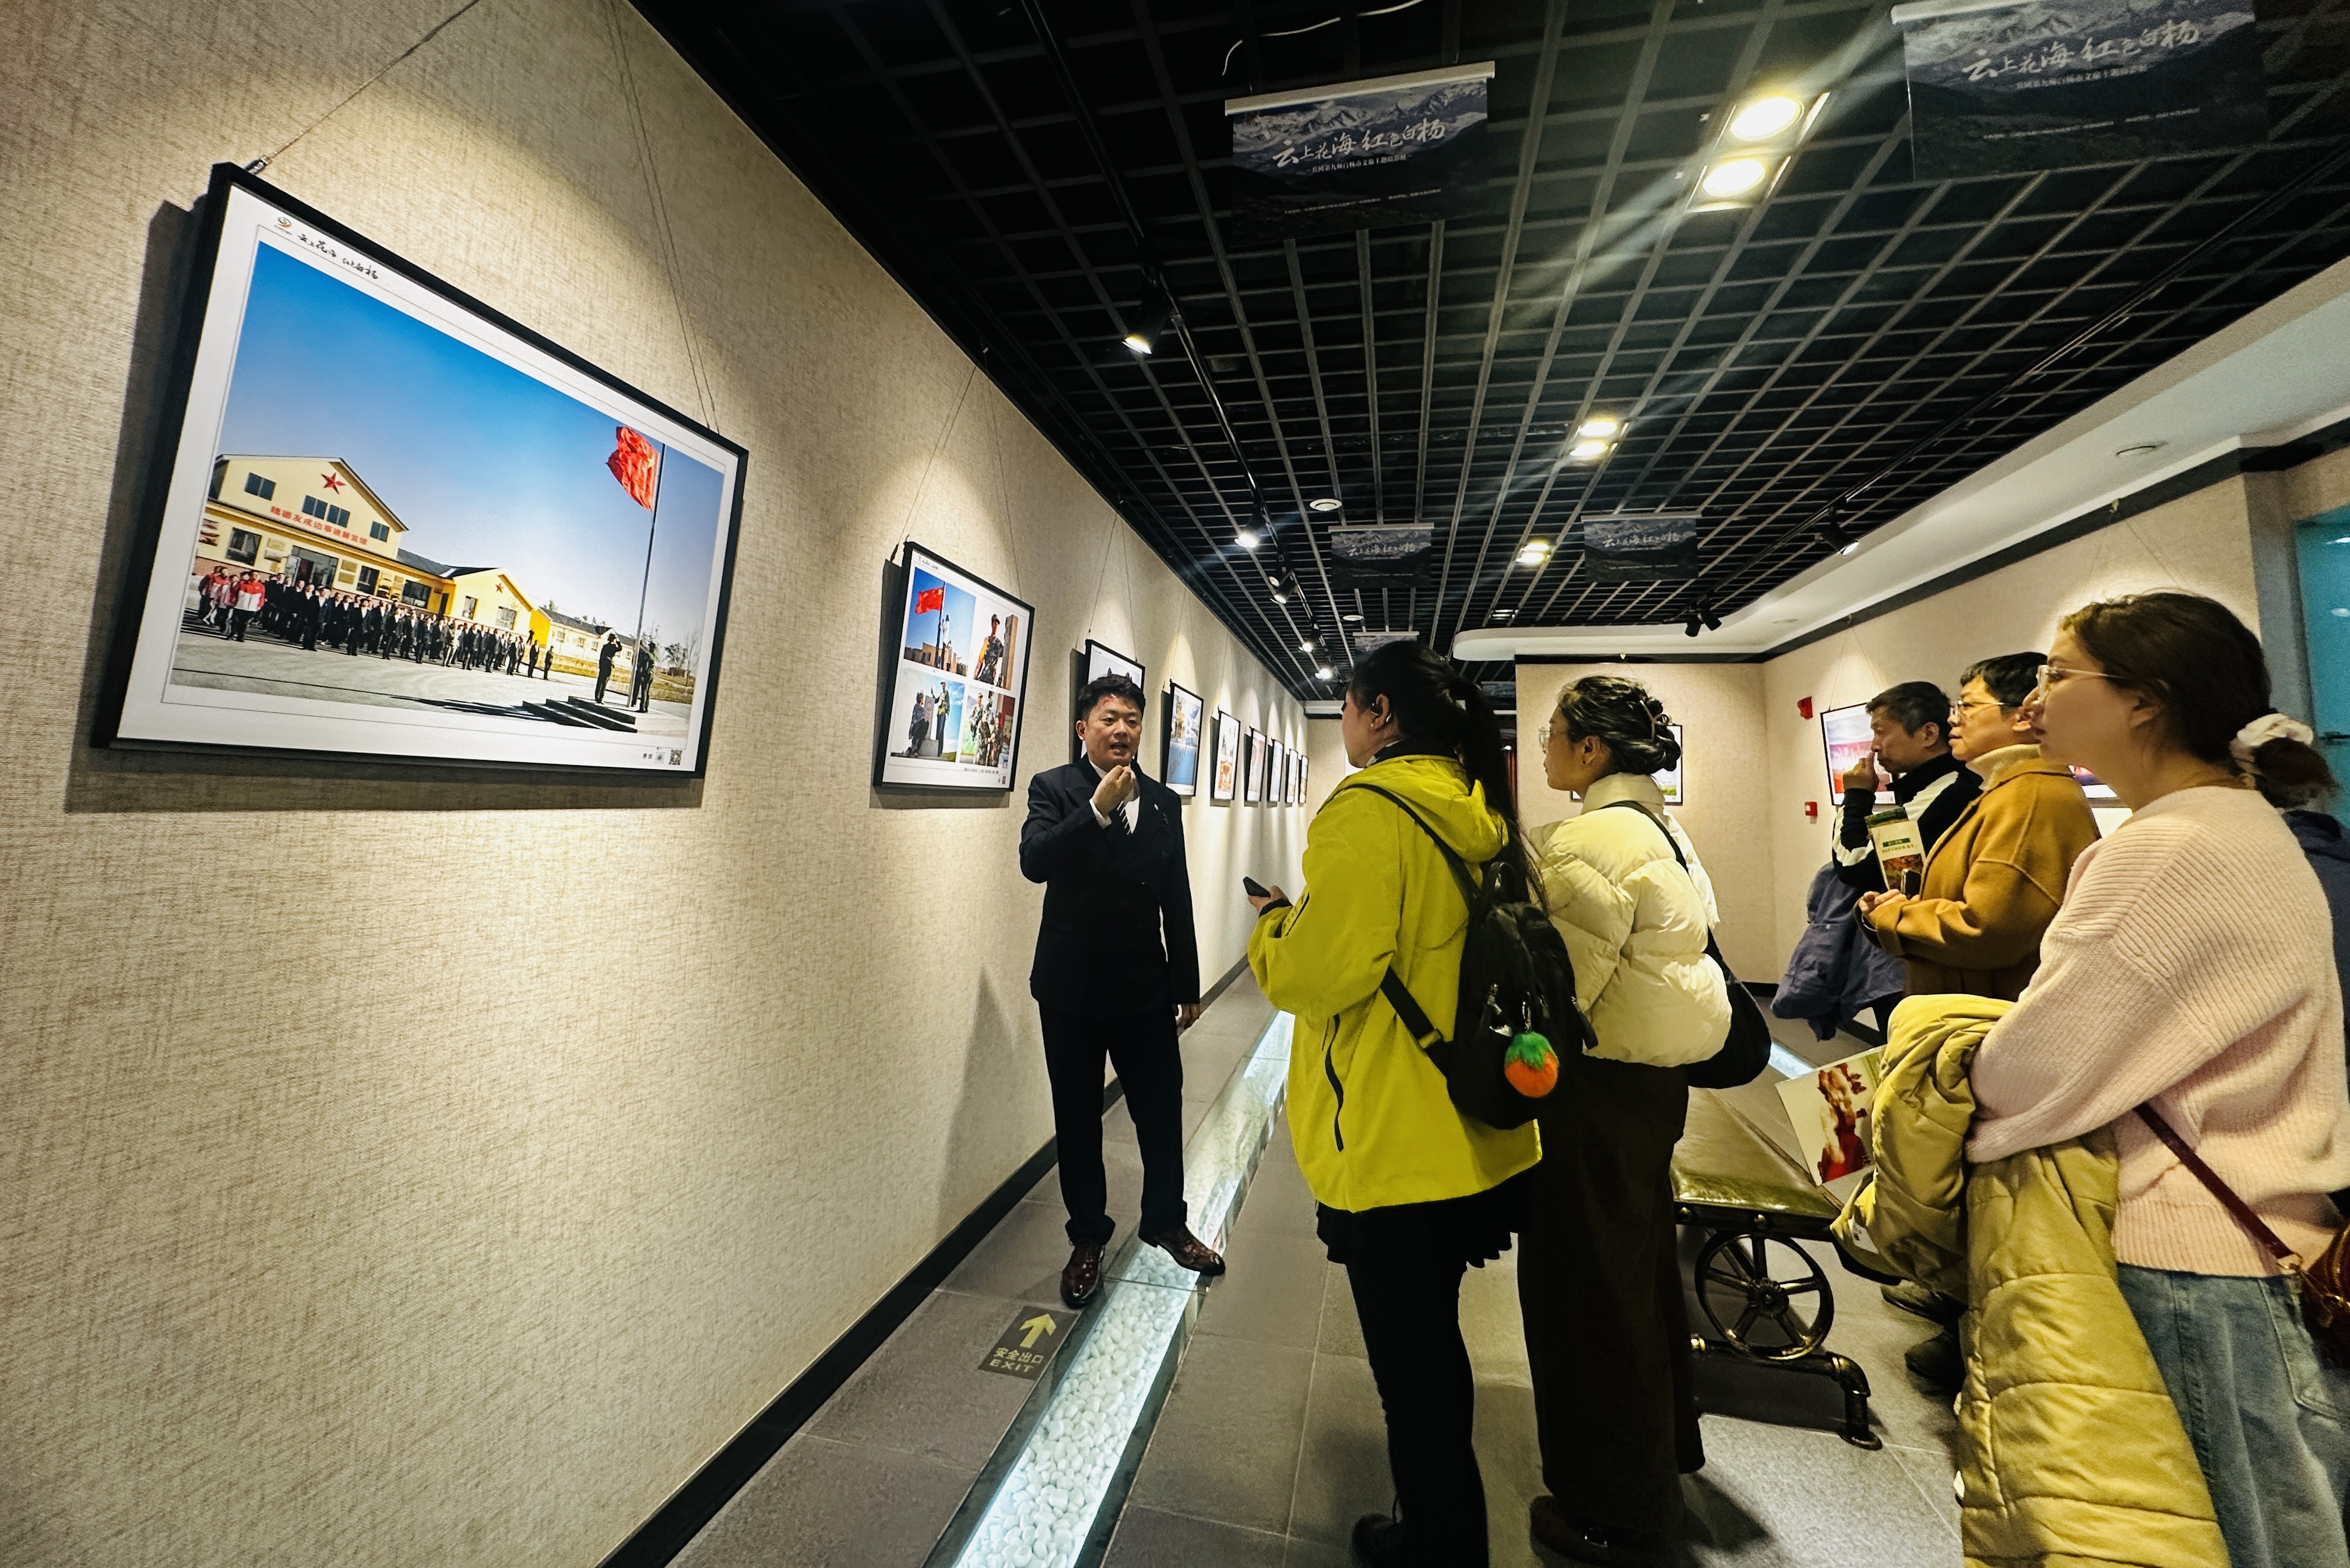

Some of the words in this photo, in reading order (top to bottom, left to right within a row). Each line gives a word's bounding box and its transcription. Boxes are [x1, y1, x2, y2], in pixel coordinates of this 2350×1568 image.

[1962, 41, 2074, 81] 云上花海
[2081, 20, 2199, 61] 红色白杨
[1273, 132, 1356, 167] 云上花海
[1362, 118, 1445, 150] 红色白杨
[990, 1359, 1035, 1373] EXIT
[994, 1347, 1044, 1364] 安全出口
